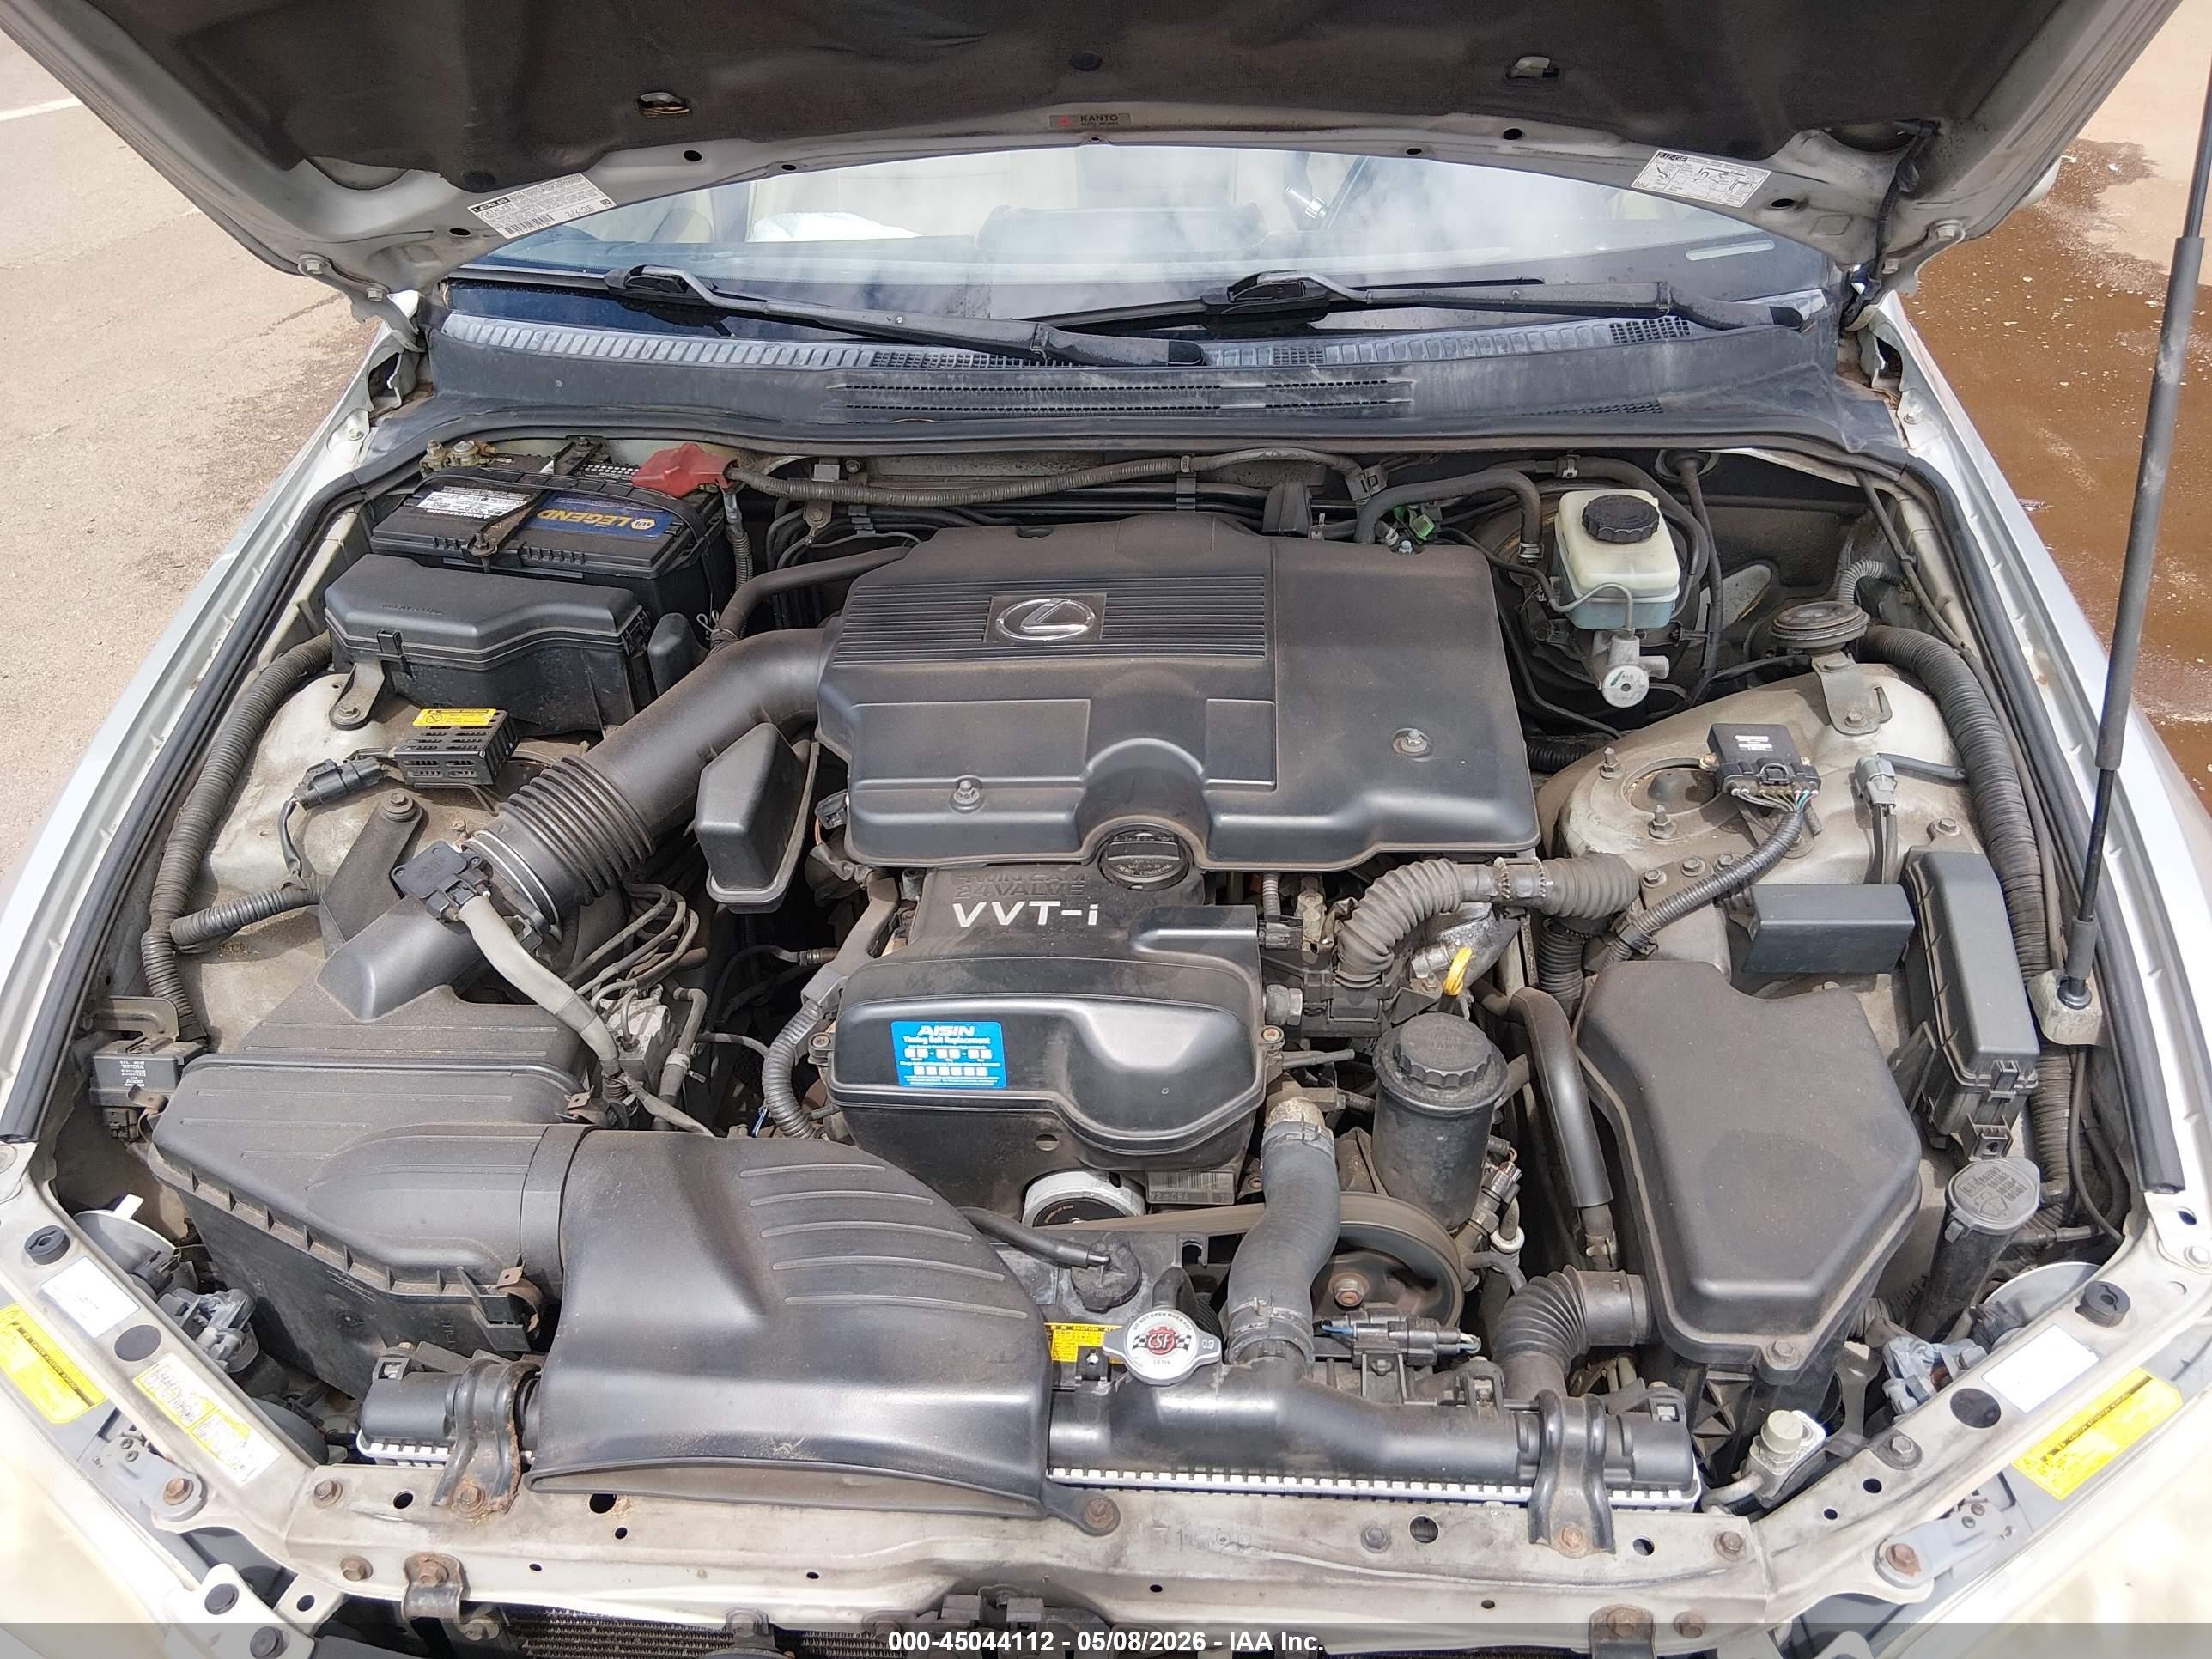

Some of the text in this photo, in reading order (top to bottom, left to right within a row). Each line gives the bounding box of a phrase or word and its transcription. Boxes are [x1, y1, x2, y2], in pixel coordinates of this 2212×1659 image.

[473, 198, 509, 212] LEXUS
[537, 509, 633, 527] LEGEND
[957, 872, 1087, 884] TWIN CAM
[955, 883, 1085, 899] 24 VALVE
[952, 901, 1099, 927] VVT-i
[916, 1025, 975, 1037] AISIN
[1168, 1312, 1183, 1322] WHEN
[1148, 1333, 1171, 1349] CSF
